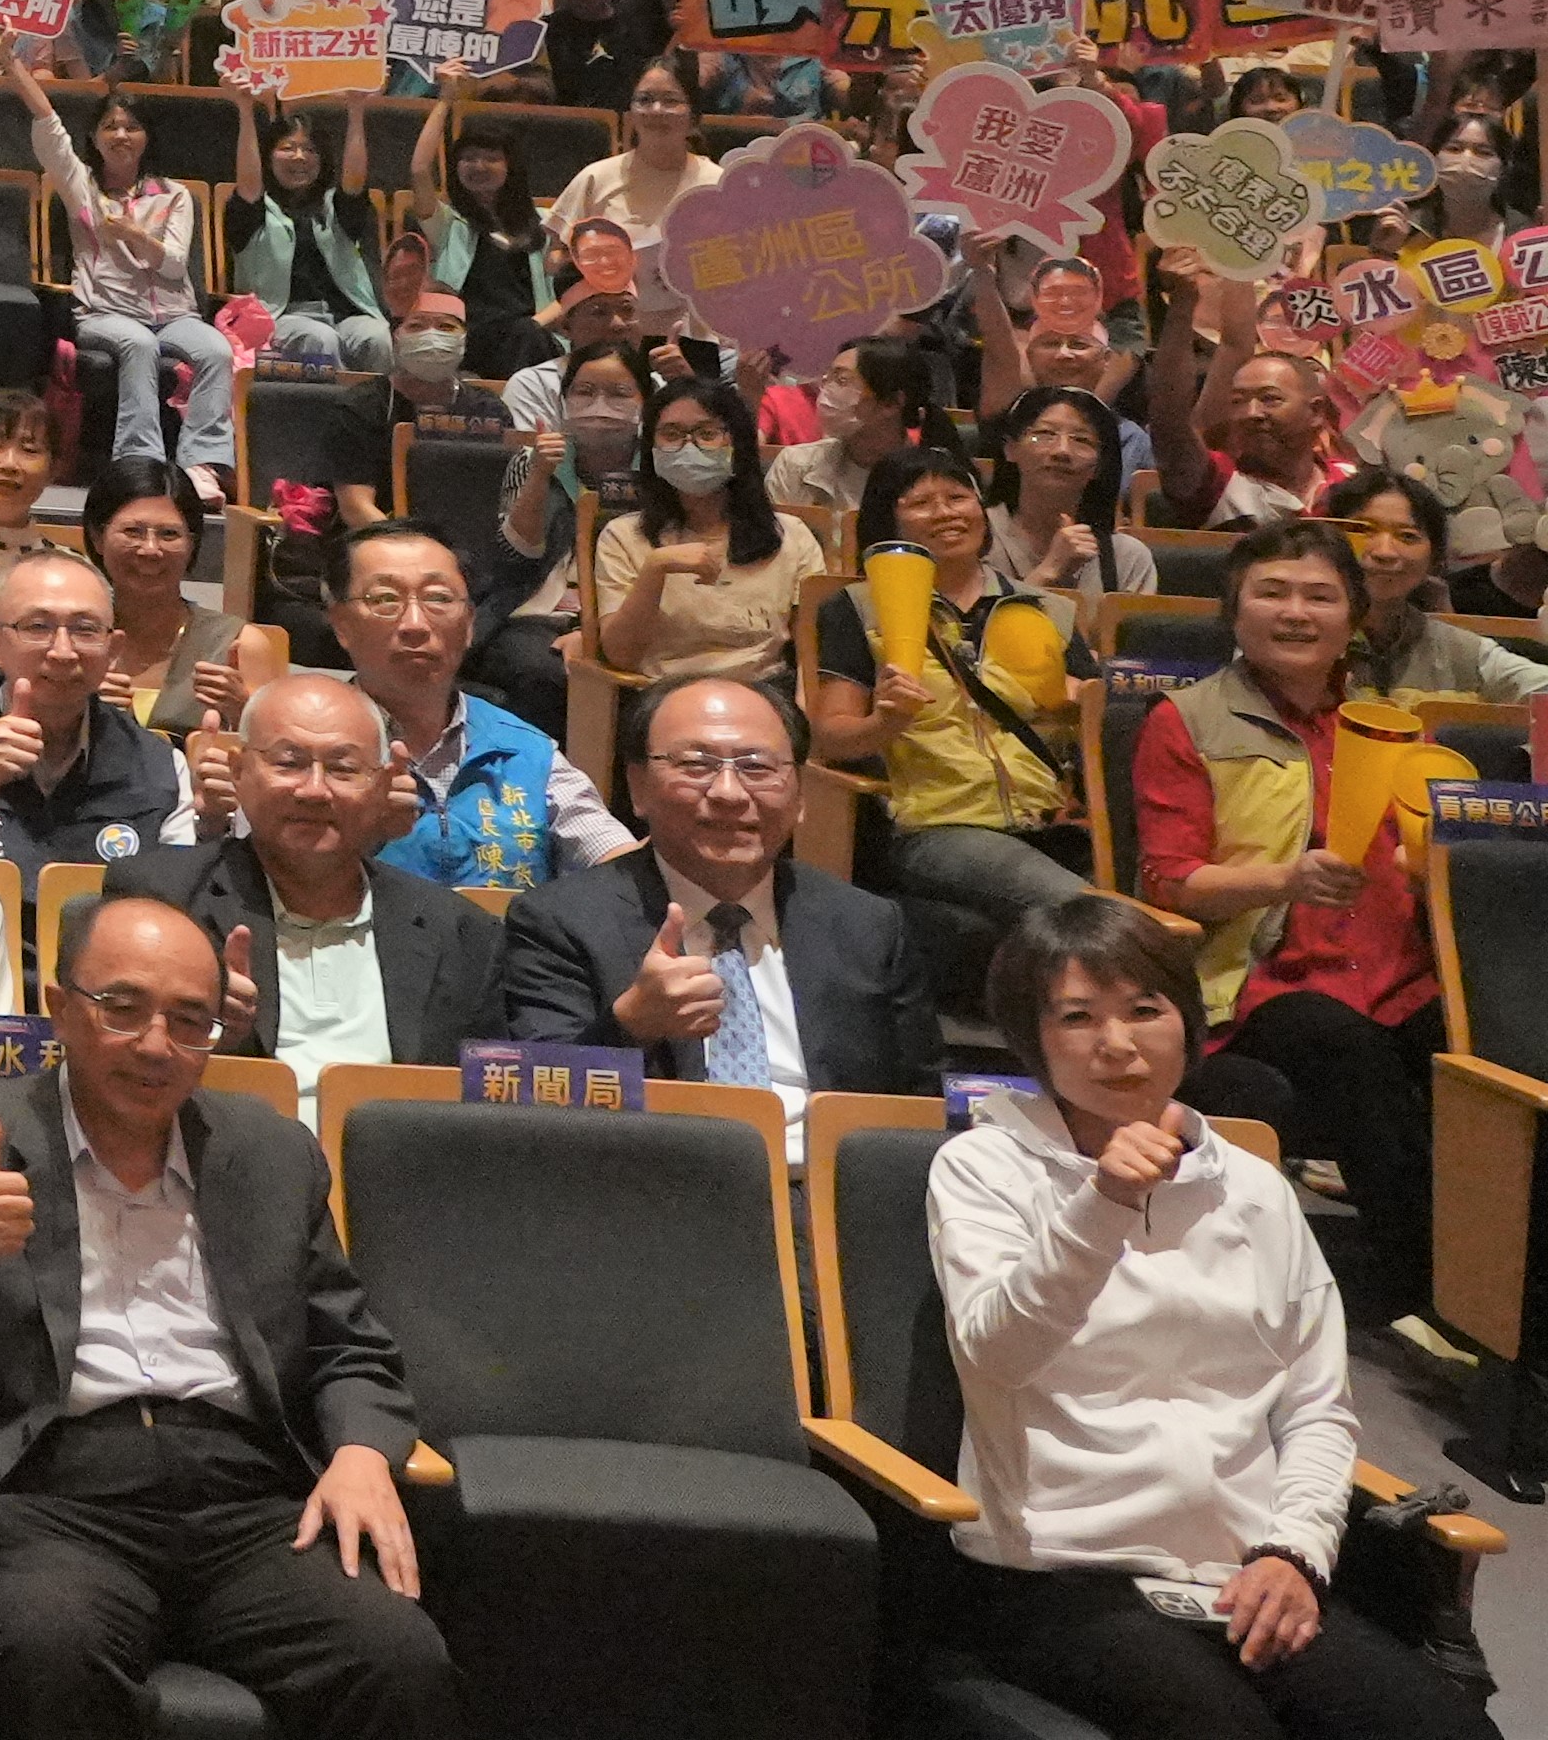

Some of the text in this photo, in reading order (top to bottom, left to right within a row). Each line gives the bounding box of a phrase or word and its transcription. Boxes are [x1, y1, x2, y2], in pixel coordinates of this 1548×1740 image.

[252, 27, 379, 57] 新莊之光
[387, 24, 501, 64] 最棒的
[972, 105, 1067, 163] 我愛
[958, 149, 1049, 208] 蘆洲
[1209, 155, 1299, 231] 優秀的
[686, 208, 867, 291] 蘆洲區
[802, 249, 918, 322] 公所
[481, 1063, 625, 1113] 新聞局
